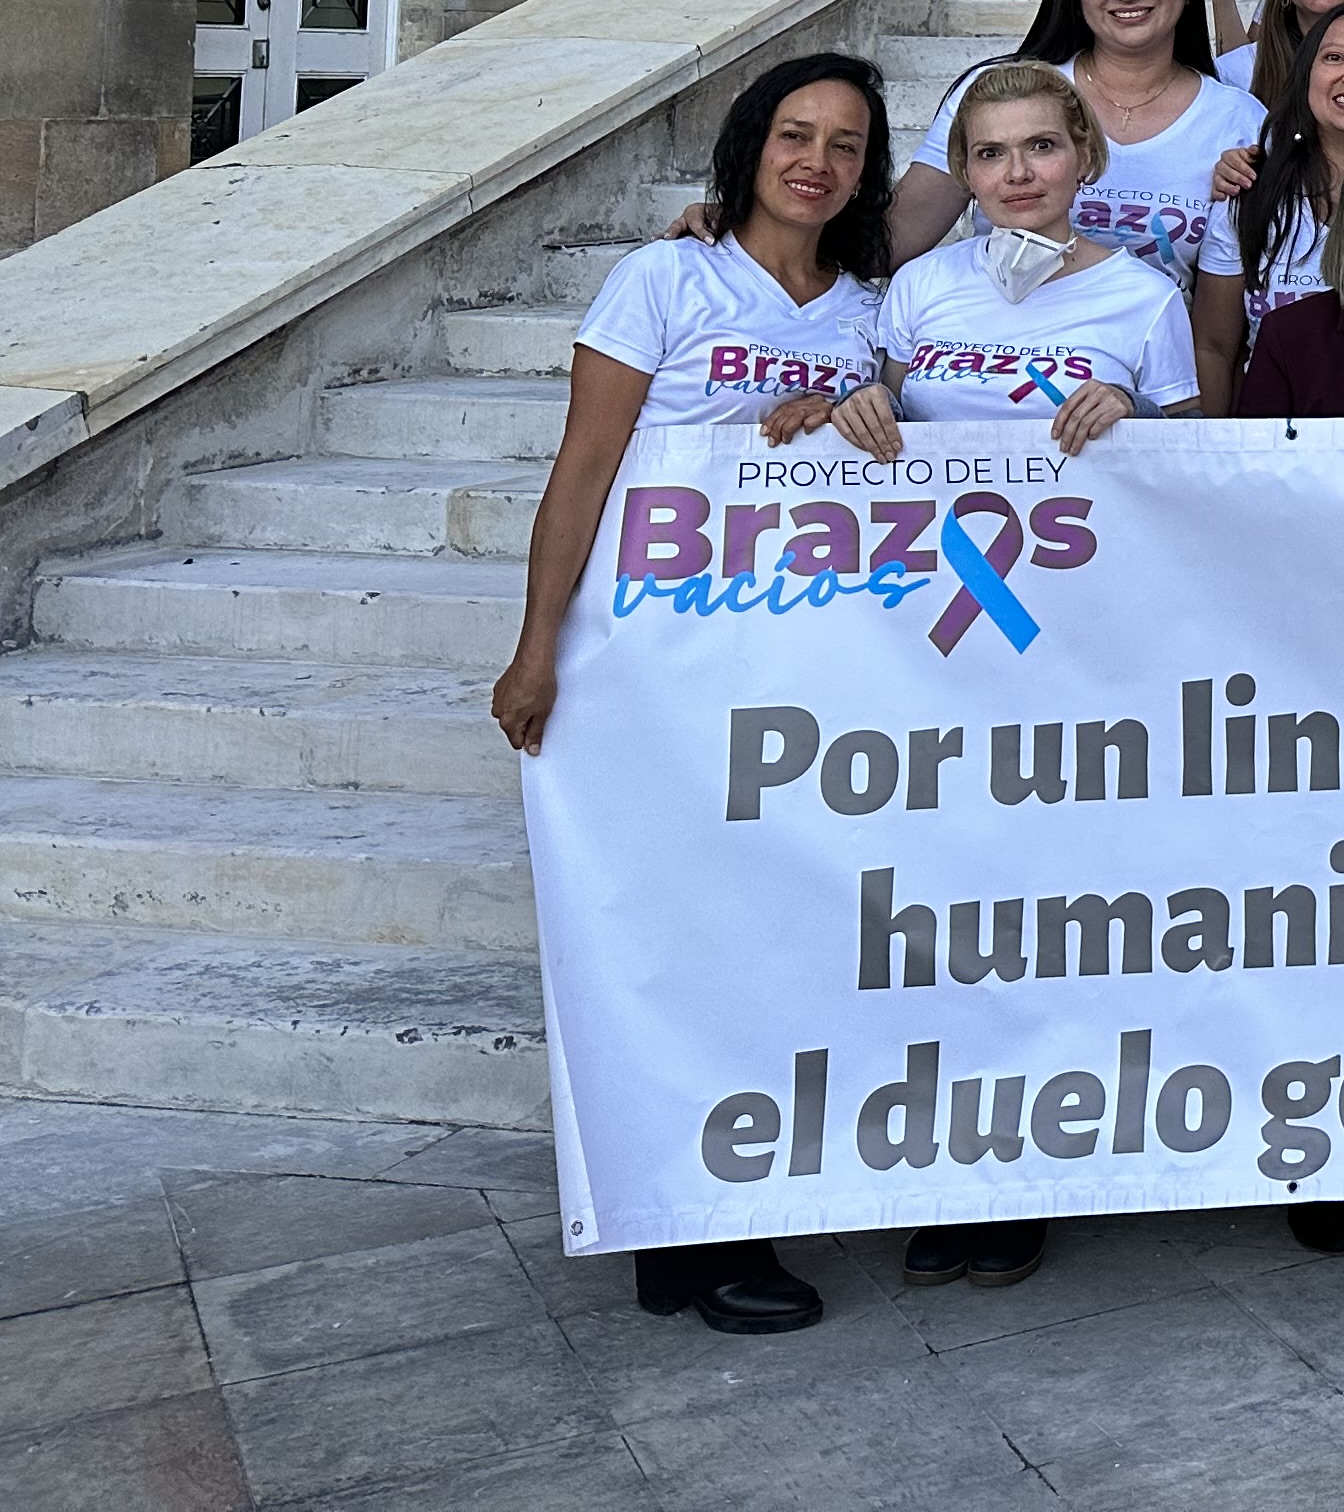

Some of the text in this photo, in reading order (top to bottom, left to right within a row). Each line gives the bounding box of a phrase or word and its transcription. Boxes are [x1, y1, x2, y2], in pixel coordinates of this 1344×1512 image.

[1159, 193, 1207, 213] DE LEY
[1076, 200, 1207, 245] azos
[750, 343, 853, 370] PROYECTO DE
[906, 344, 1093, 380] Brazos
[935, 341, 1076, 357] PROYECTO DE LEY
[739, 456, 1068, 488] PROYECTO DE LEY
[616, 486, 1098, 582] Brazos
[726, 704, 964, 823] Por
[989, 718, 1149, 806] un
[702, 1047, 830, 1184] el
[856, 1028, 1232, 1172] duelo
